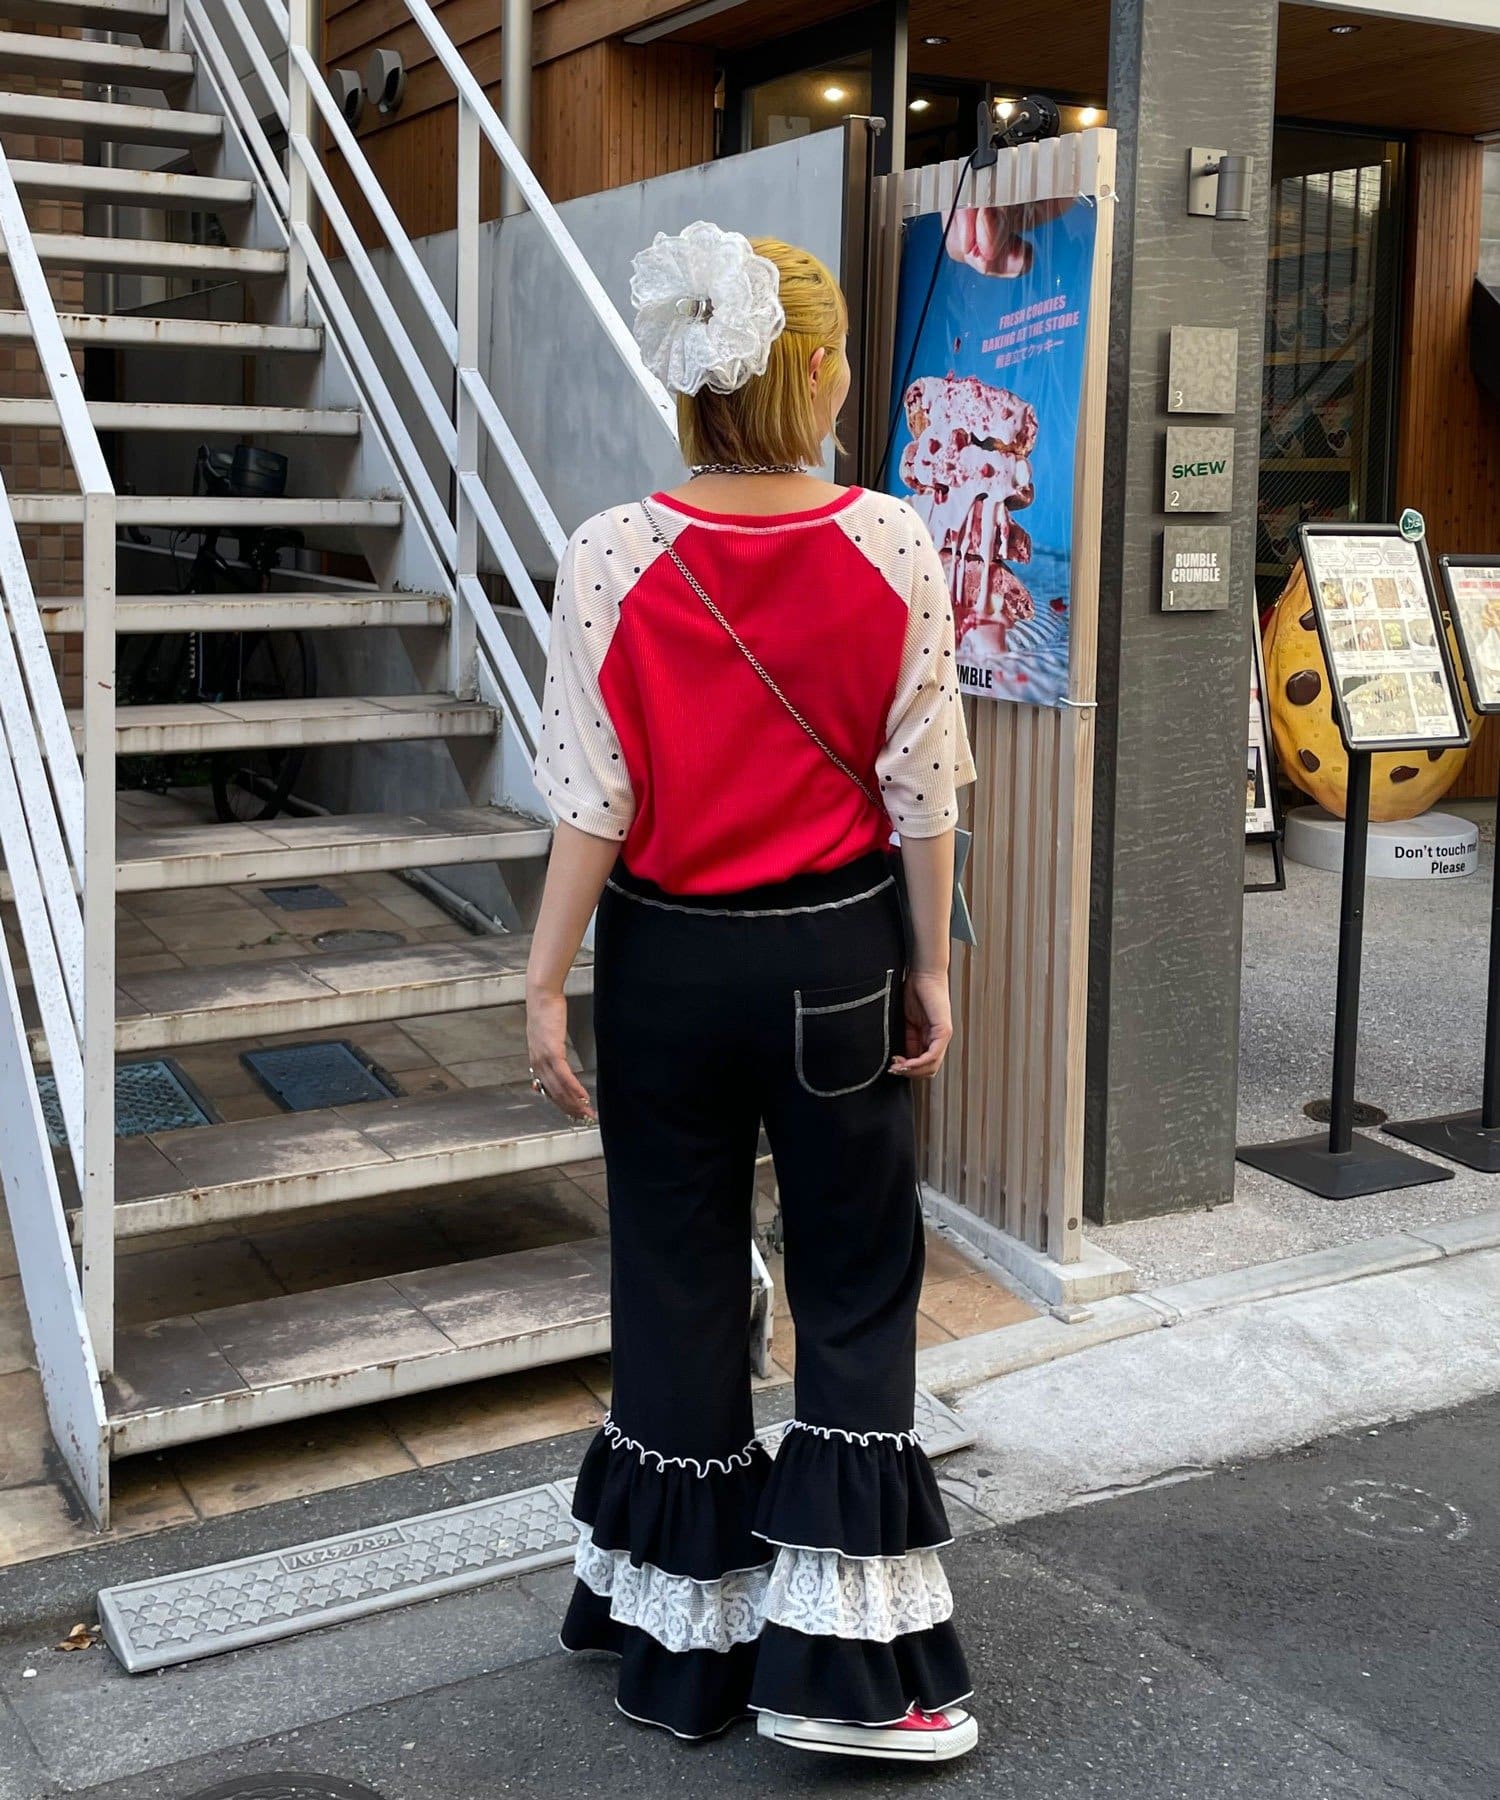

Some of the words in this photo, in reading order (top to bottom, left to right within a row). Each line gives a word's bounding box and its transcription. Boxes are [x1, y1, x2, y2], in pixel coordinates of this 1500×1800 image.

[999, 309, 1026, 330] FRESH
[1026, 295, 1066, 320] COOKIES
[982, 331, 1016, 353] BAKING
[1016, 327, 1027, 343] AT
[1028, 320, 1044, 338] THE
[1045, 310, 1079, 332] STORE
[1173, 390, 1183, 408] 3
[1172, 460, 1226, 478] SKEW
[1170, 490, 1180, 507] 2
[1175, 553, 1217, 567] RUMBLE
[1171, 568, 1221, 583] CRUMBLE
[1168, 590, 1174, 606] 1
[1395, 845, 1433, 858] Don't
[1436, 843, 1466, 857] touch
[1431, 861, 1466, 874] Please
